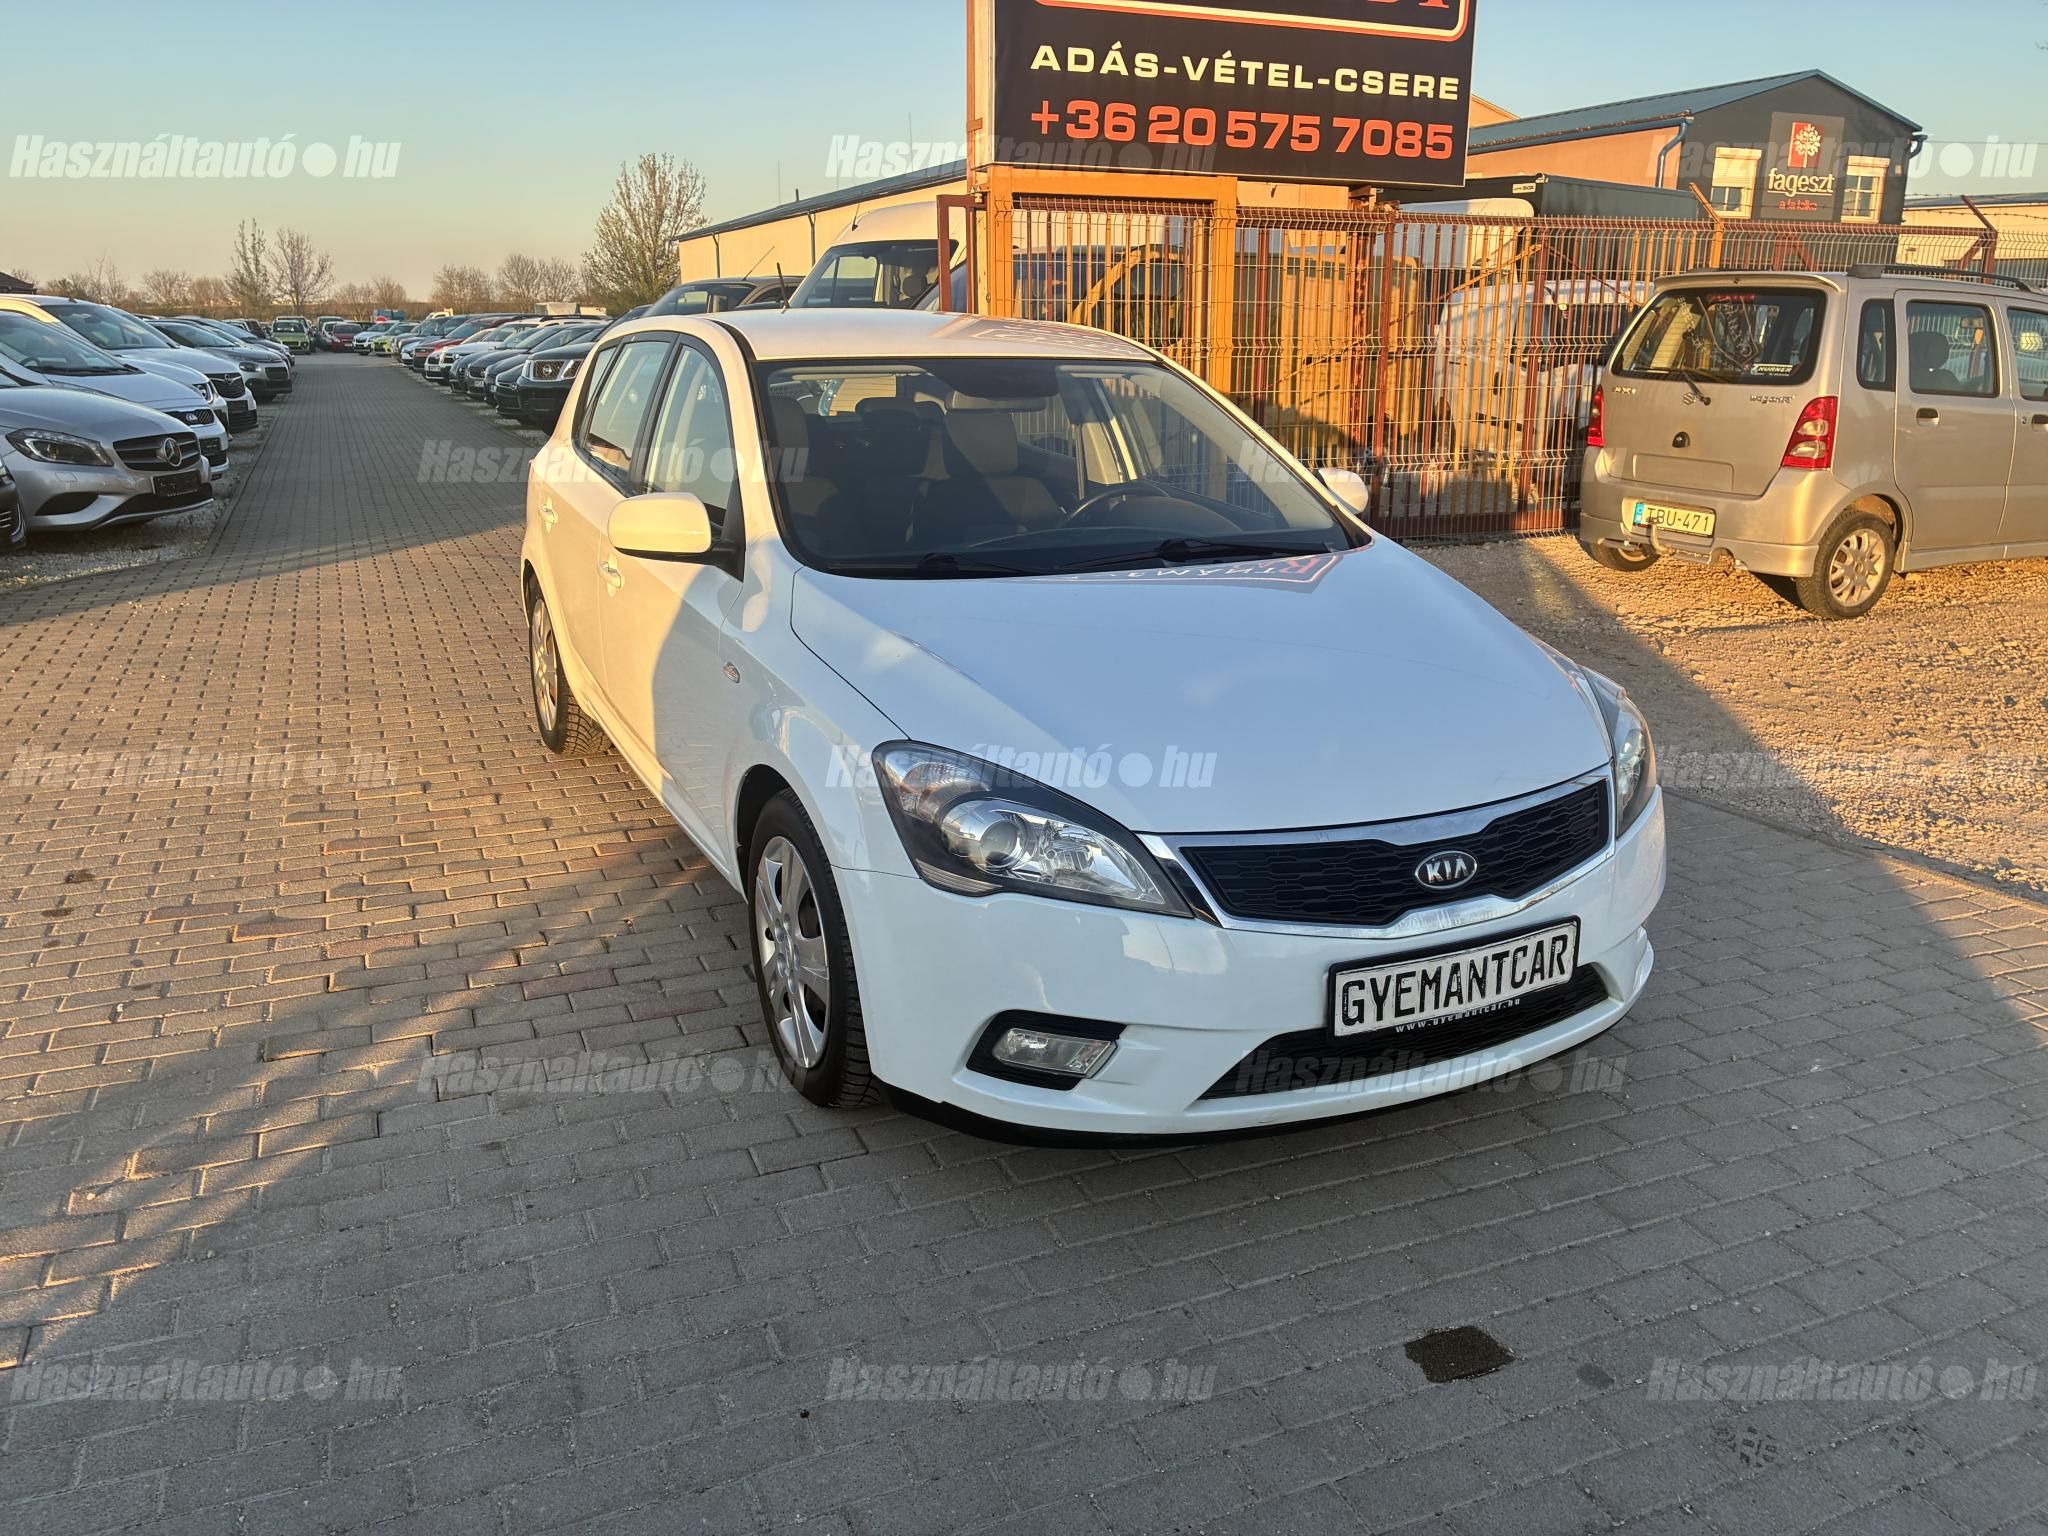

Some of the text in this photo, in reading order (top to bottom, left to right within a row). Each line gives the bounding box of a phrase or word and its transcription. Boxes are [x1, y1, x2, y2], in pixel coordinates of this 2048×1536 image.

[1030, 41, 1460, 100] ADÁS-VÉTEL-CSERE
[1031, 100, 1454, 160] +36 20 575 7085
[1768, 167, 1835, 197] fageszt
[1647, 507, 1709, 532] TBU-471
[1426, 857, 1470, 883] KIA
[1341, 933, 1567, 1027] GYEMANTCAR
